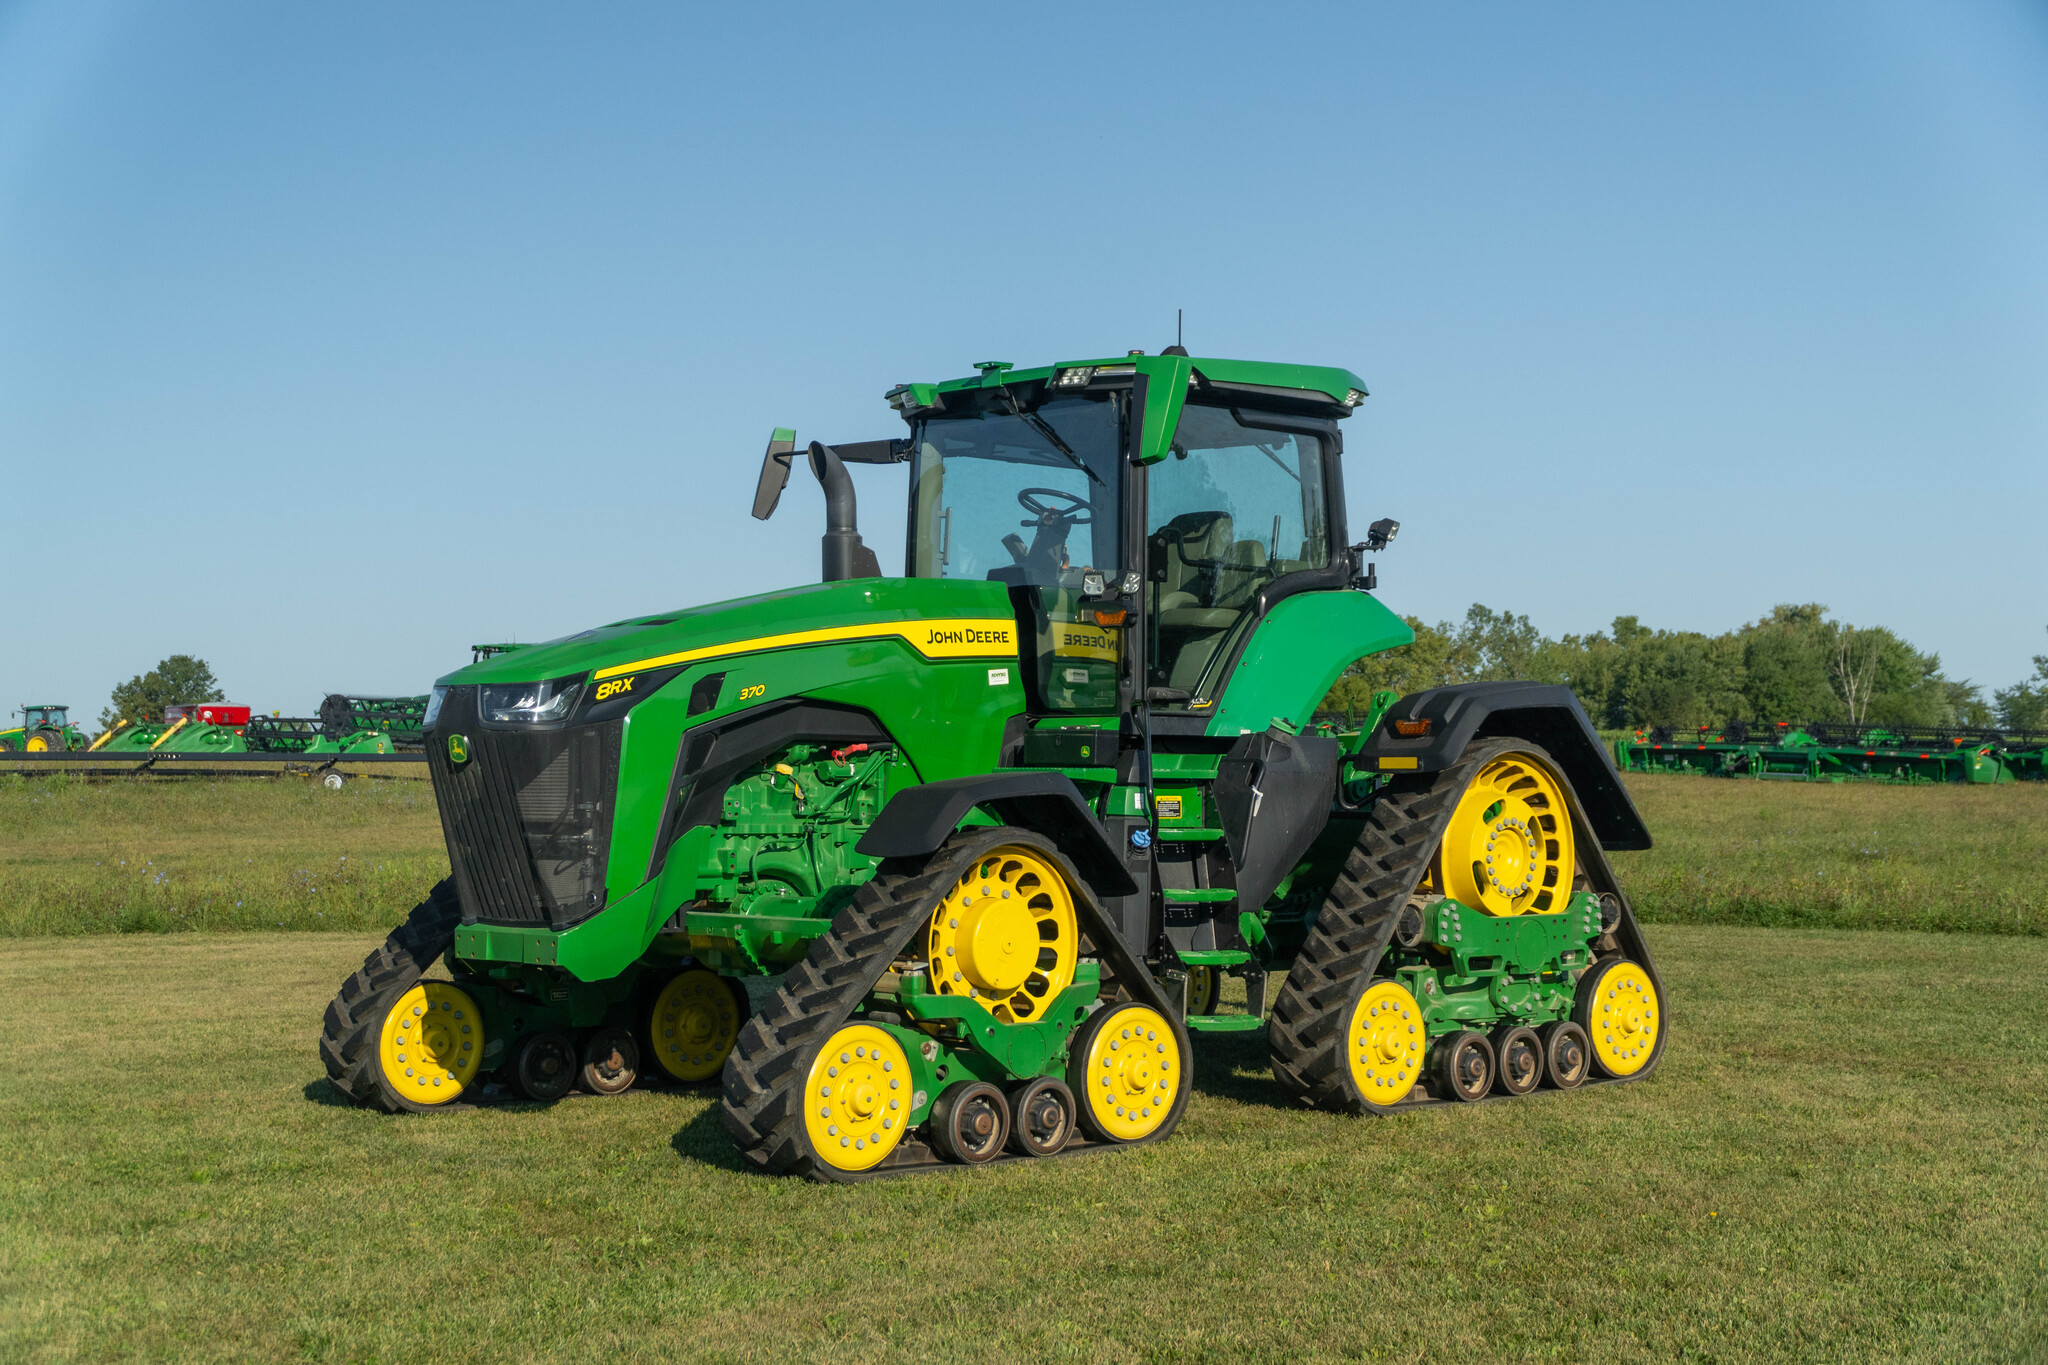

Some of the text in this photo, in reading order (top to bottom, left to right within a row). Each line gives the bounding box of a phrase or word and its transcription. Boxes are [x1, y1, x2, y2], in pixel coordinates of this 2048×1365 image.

[927, 628, 1010, 644] JOHN DEERE
[595, 676, 636, 700] 8RX
[739, 684, 766, 700] 370
